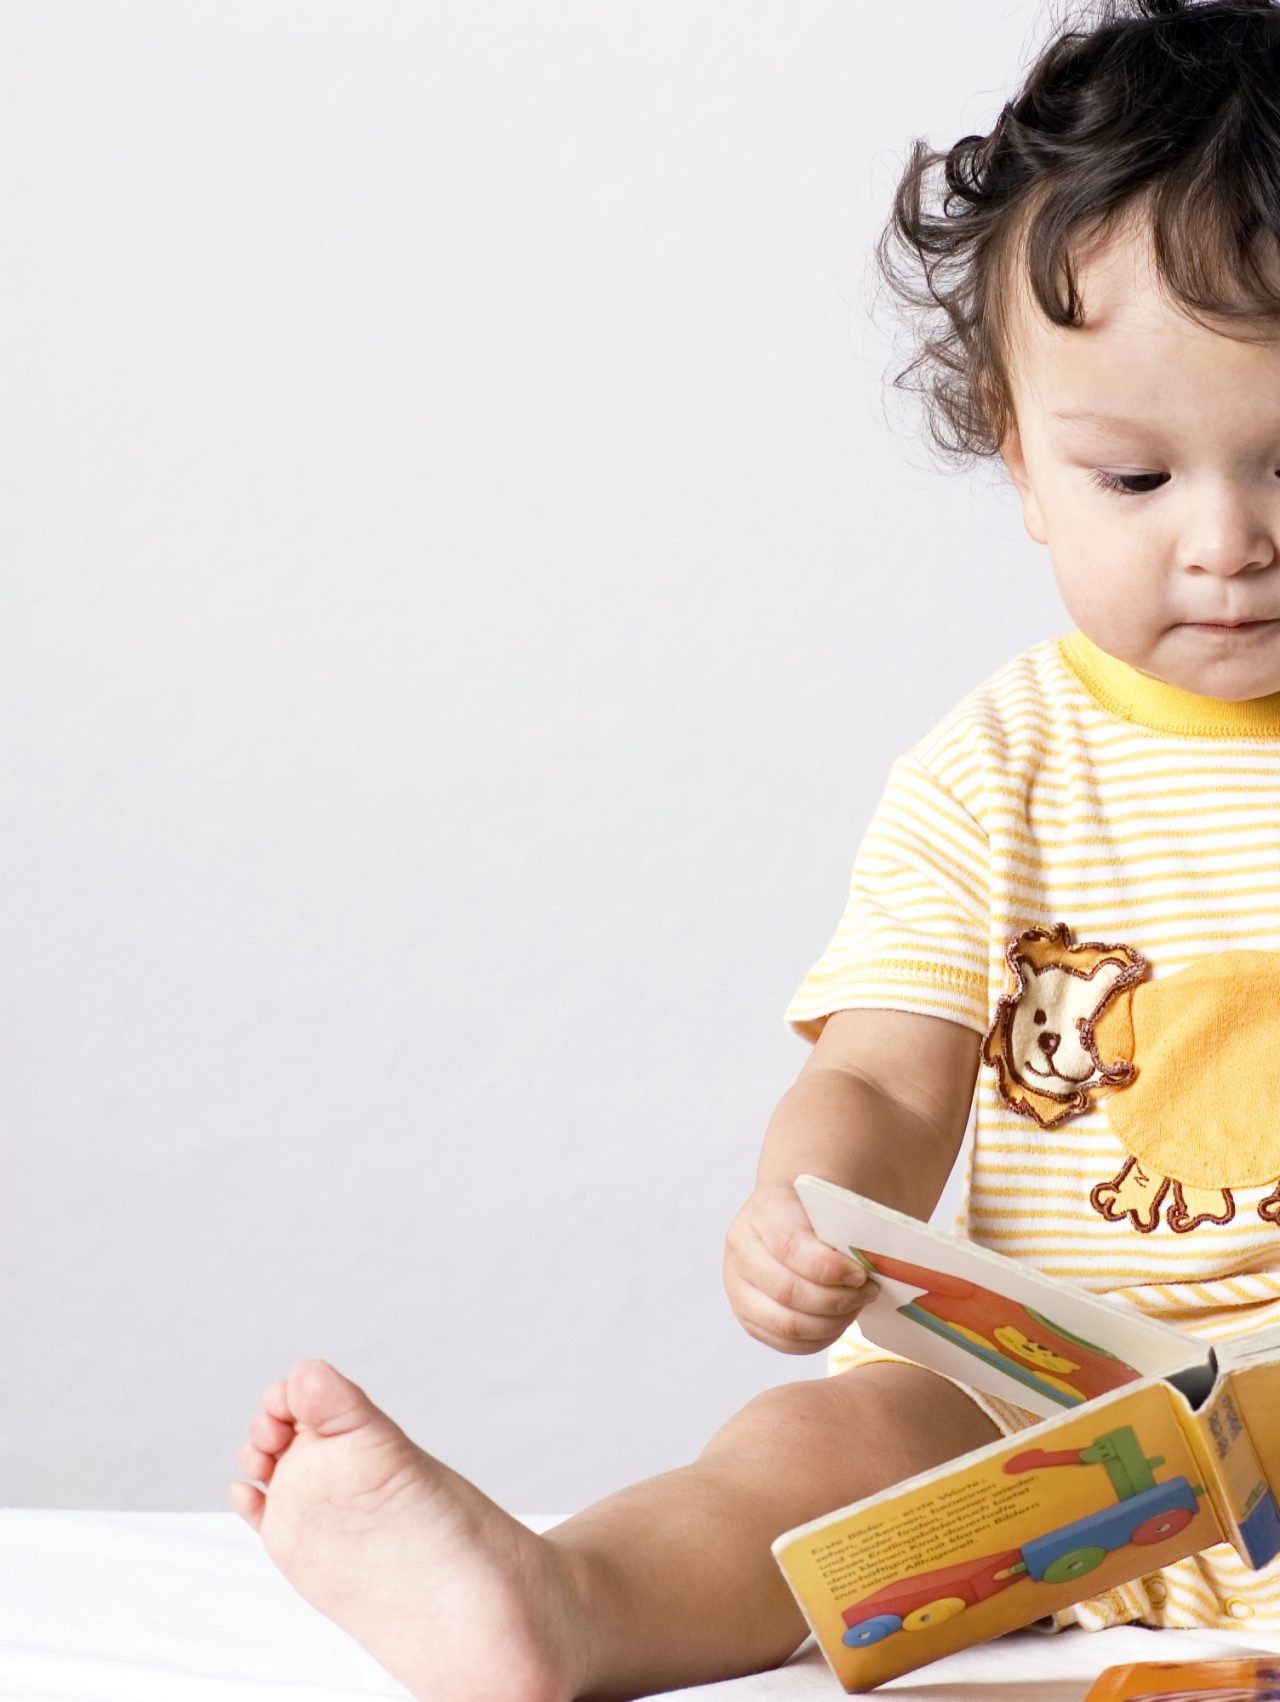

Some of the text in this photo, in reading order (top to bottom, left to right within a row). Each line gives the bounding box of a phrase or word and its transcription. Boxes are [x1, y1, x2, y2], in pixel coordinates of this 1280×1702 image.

[848, 1522, 883, 1540] Bilder
[849, 1538, 892, 1557] wieder
[947, 1497, 986, 1516] immer
[926, 1542, 945, 1553] mit
[950, 1524, 991, 1543] klaren
[994, 1503, 1040, 1524] Bildern
[827, 1571, 856, 1585] dem
[860, 1551, 906, 1571] kleinen
[910, 1535, 939, 1550] Kind
